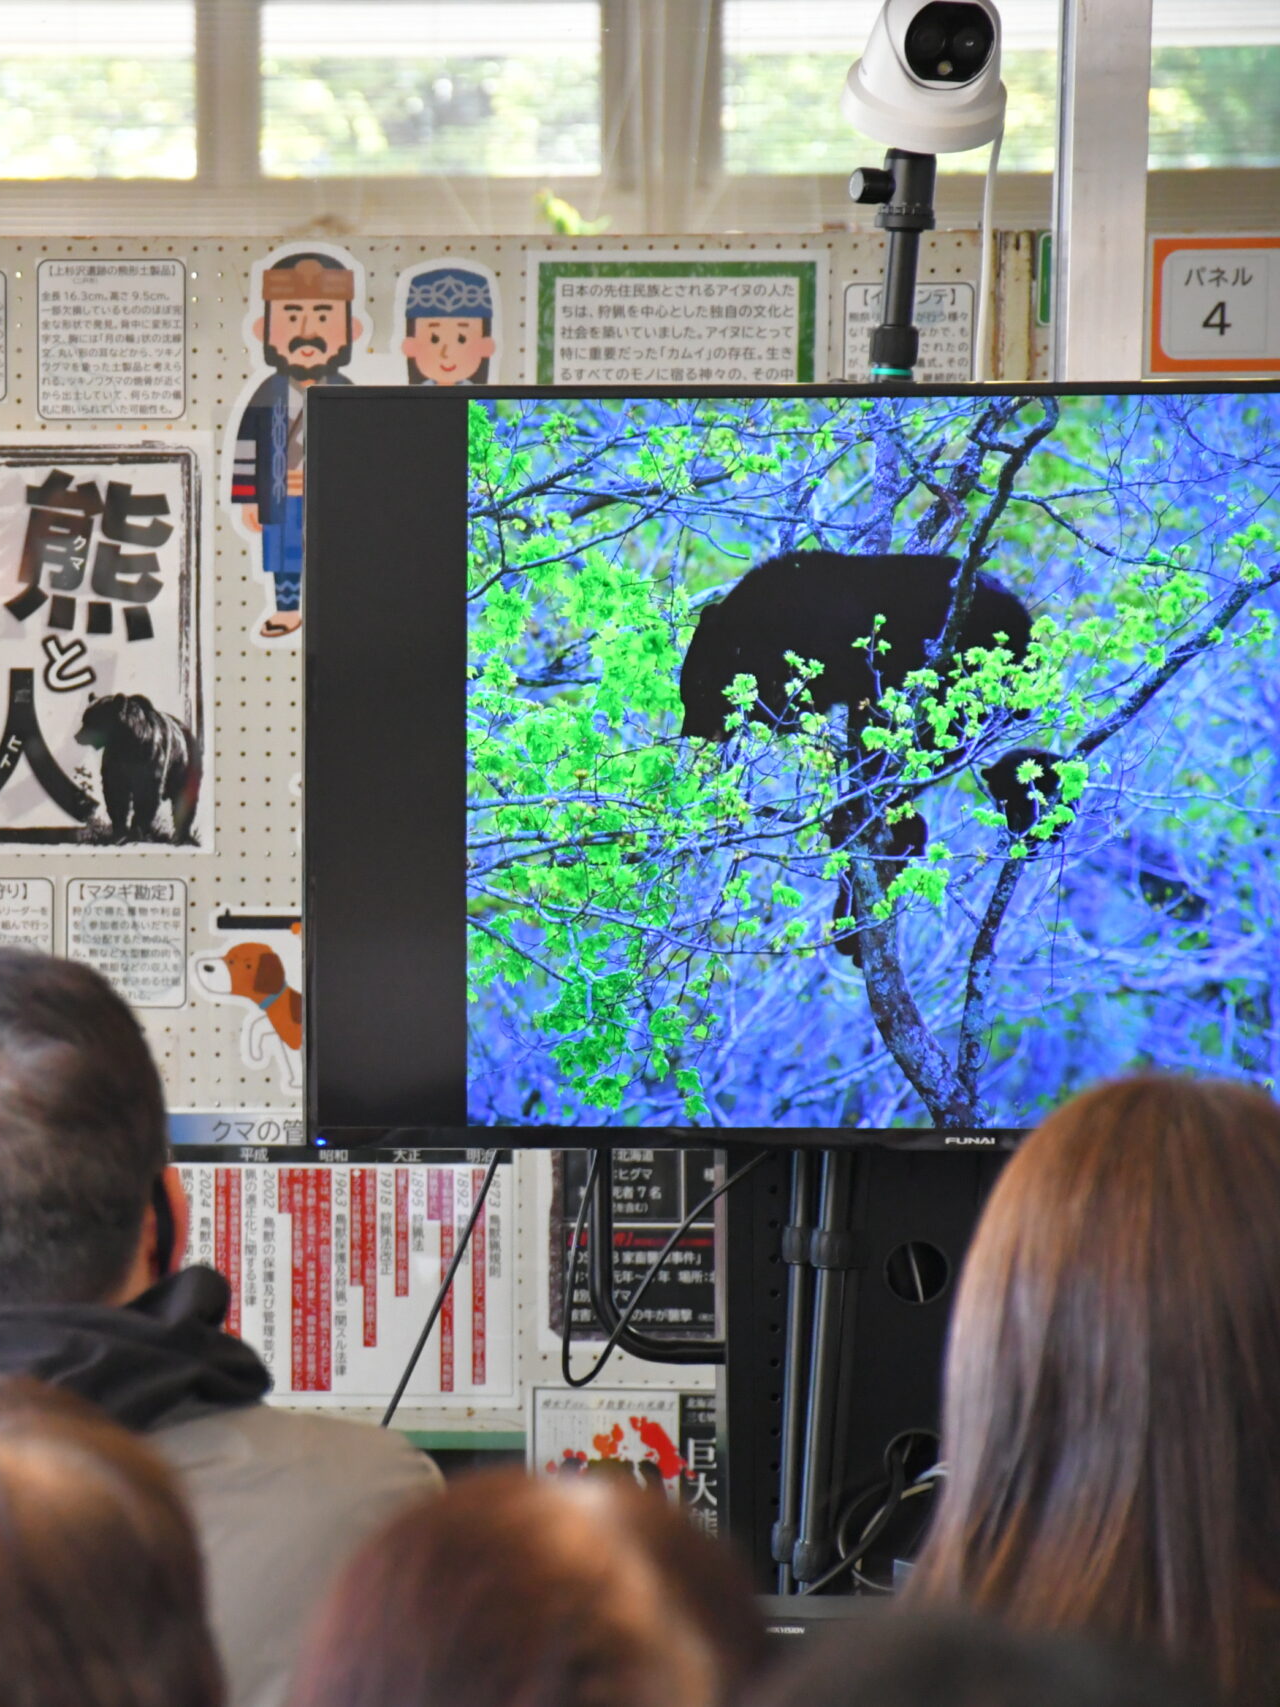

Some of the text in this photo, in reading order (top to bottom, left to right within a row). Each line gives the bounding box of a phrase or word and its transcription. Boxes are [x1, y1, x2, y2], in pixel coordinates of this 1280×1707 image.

[1184, 267, 1253, 288] パネル
[561, 283, 795, 298] 日本の先住民族とされるアイヌの人た
[562, 304, 794, 319] ちは、狩猟を中心とした独自の文化と
[1202, 301, 1232, 336] 4
[560, 325, 794, 340] 社会を築いていました。アイヌにとって
[560, 347, 793, 361] 特に重要だった「カムイ」の存在。生き
[561, 367, 794, 382] るすべてのモノに宿る神々の、その中
[70, 535, 85, 570] クマ
[78, 883, 175, 901] 【マタギ勘定】
[945, 1136, 996, 1145] FUNAI
[240, 1147, 269, 1162] 平成
